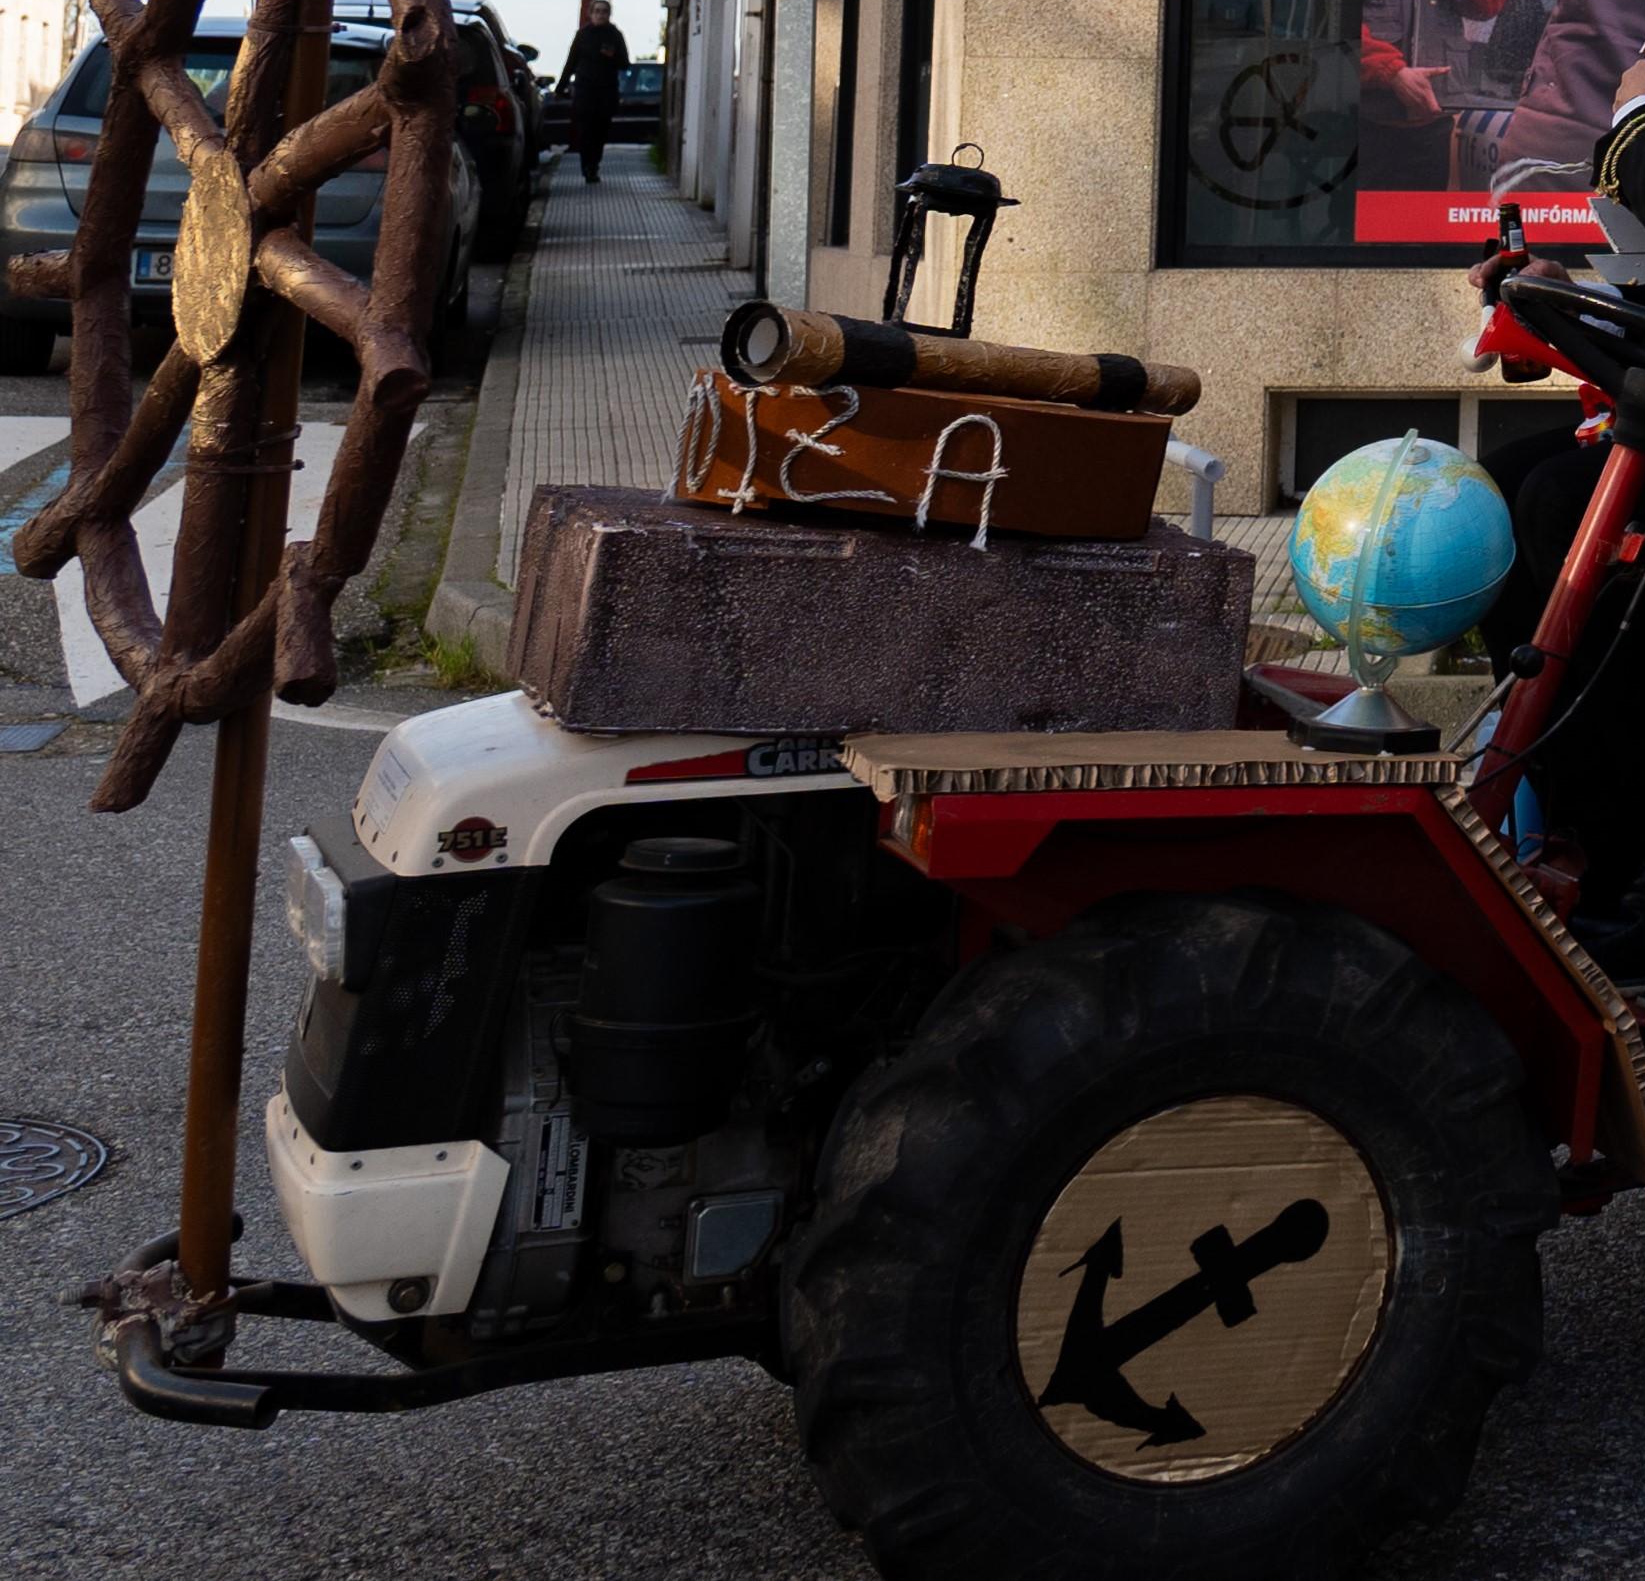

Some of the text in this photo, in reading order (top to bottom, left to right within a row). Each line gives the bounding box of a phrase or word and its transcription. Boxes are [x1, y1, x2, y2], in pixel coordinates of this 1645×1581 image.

[1448, 204, 1601, 225] ENTRA INFÓRMA
[748, 744, 841, 776] CARR
[565, 1144, 581, 1213] LOMBARDINI
